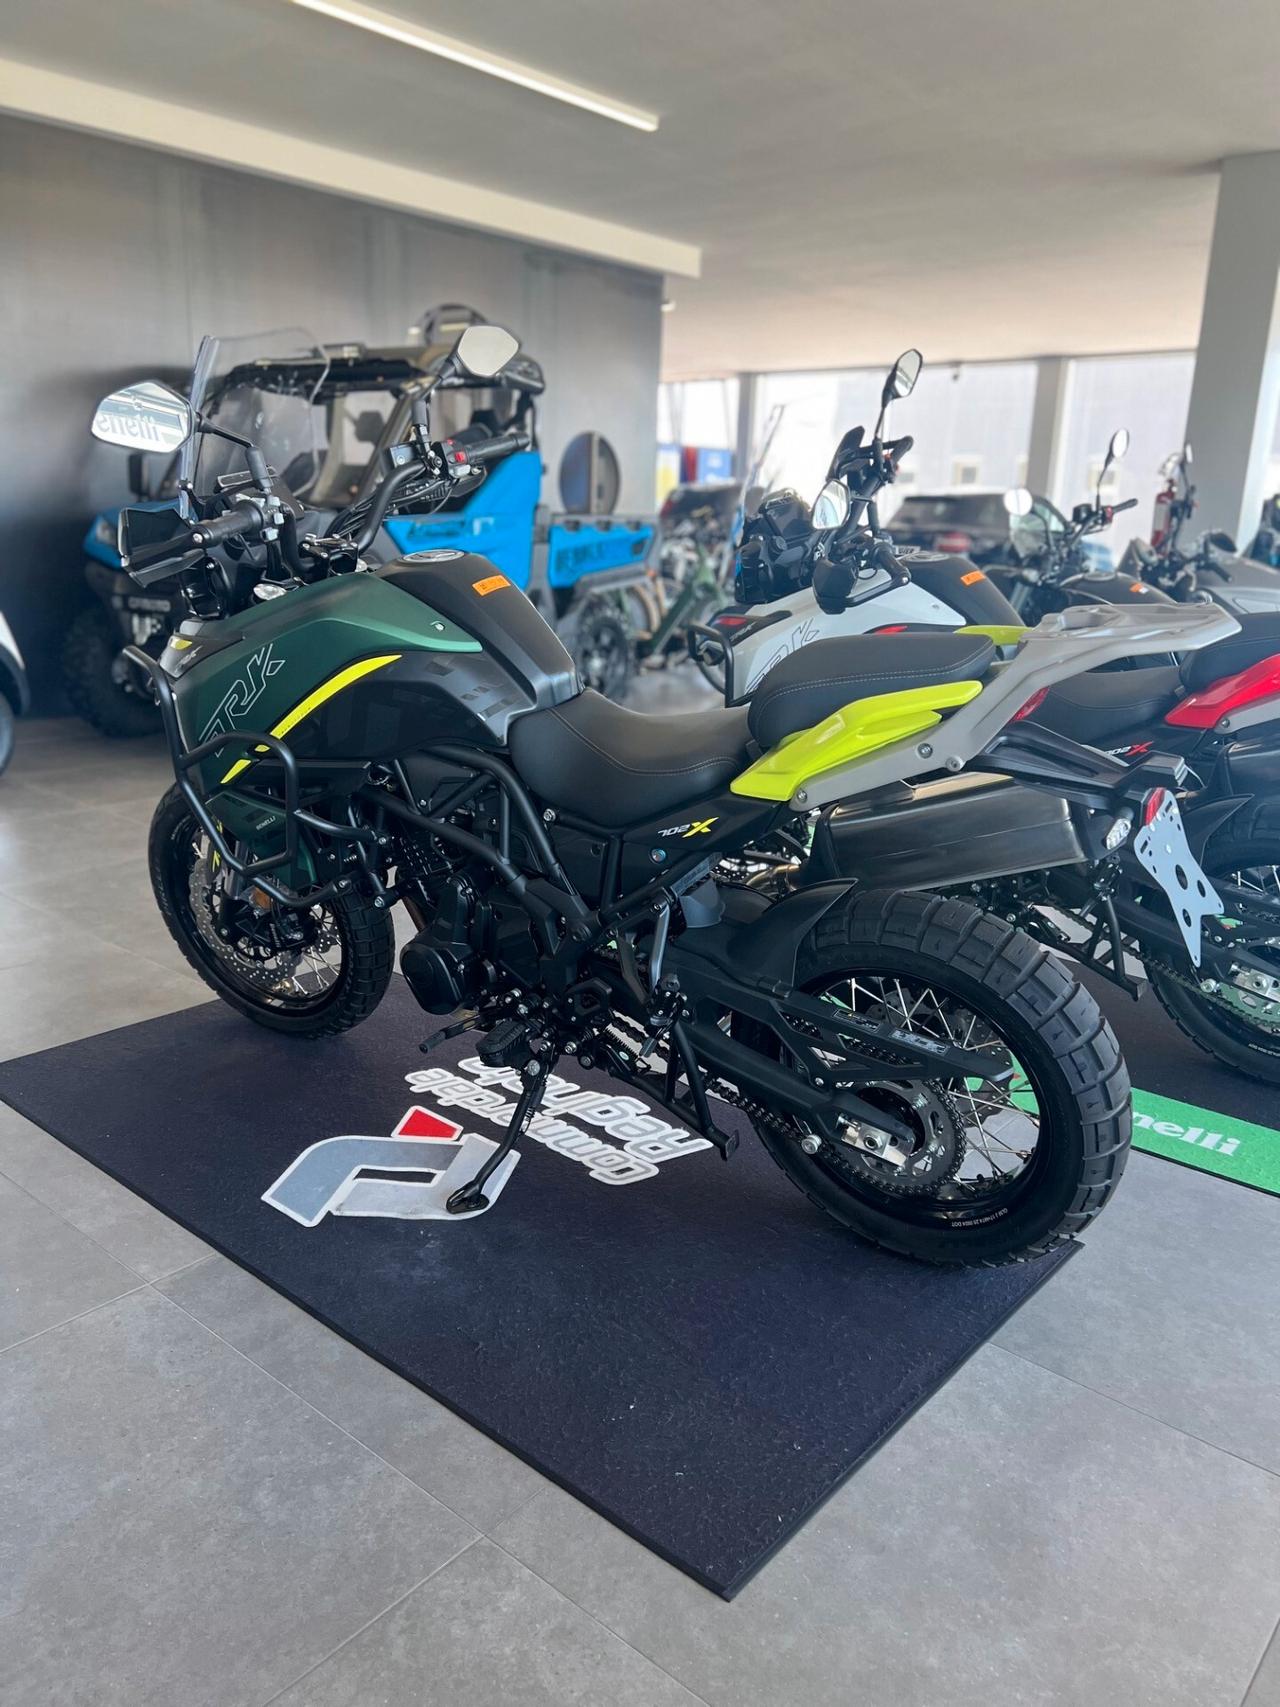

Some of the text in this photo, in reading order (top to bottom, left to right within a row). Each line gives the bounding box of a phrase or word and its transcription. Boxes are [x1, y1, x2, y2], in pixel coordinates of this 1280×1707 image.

[96, 412, 160, 442] enelli
[255, 815, 277, 831] BENELLI
[657, 816, 720, 838] 702X
[1132, 1111, 1241, 1156] nelli
